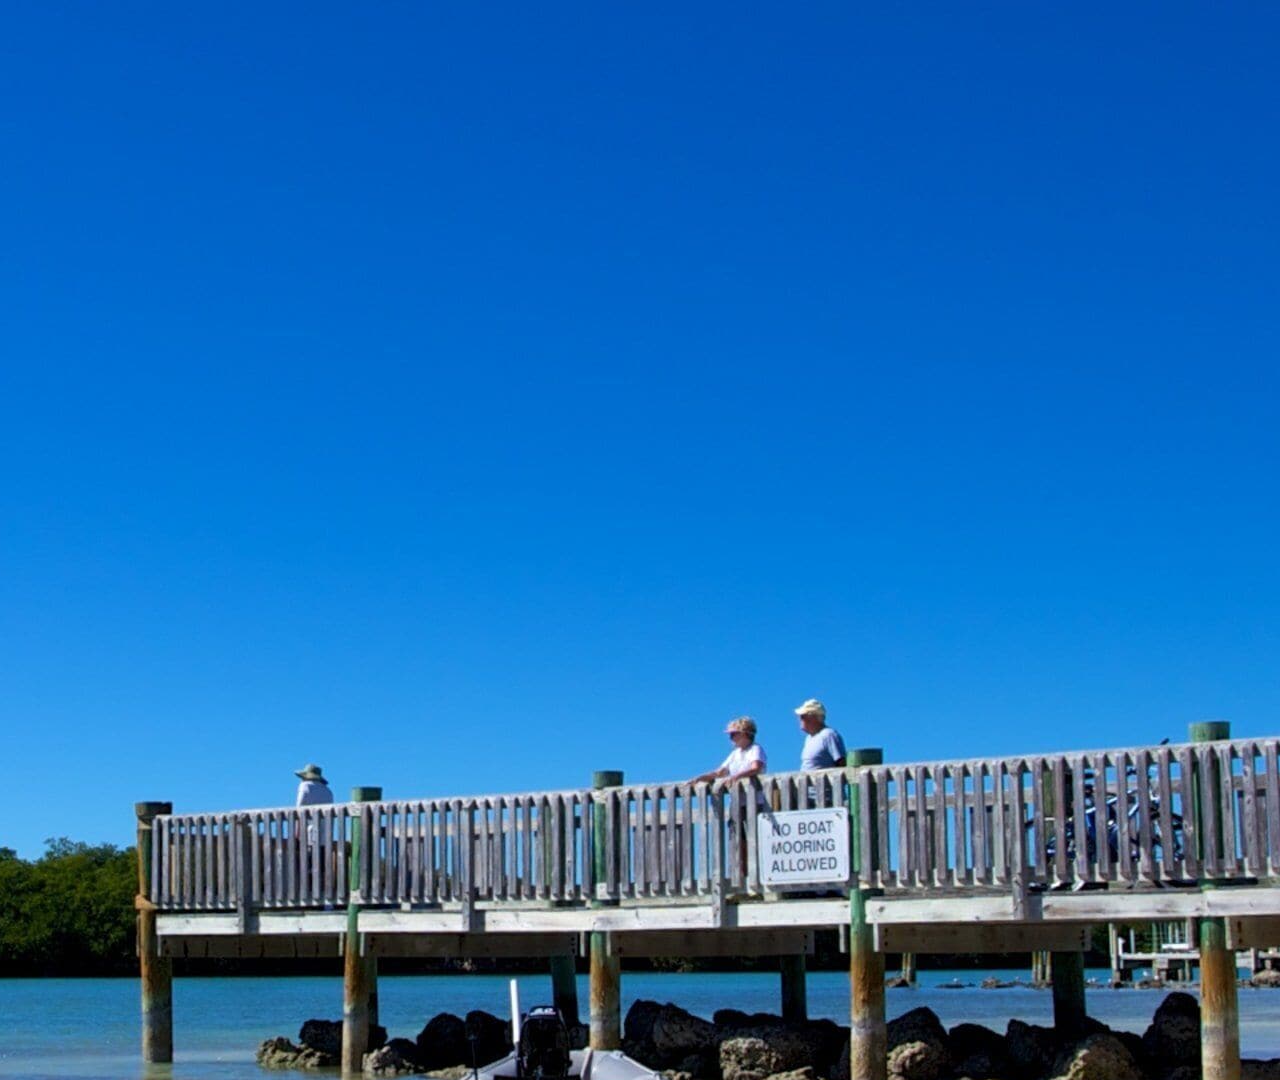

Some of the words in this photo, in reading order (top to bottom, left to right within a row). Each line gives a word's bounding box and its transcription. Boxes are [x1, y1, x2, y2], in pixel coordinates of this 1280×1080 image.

[771, 822, 791, 837] NO
[798, 820, 833, 835] BOAT
[771, 838, 836, 855] MOORING
[771, 856, 838, 873] ALLOWED
